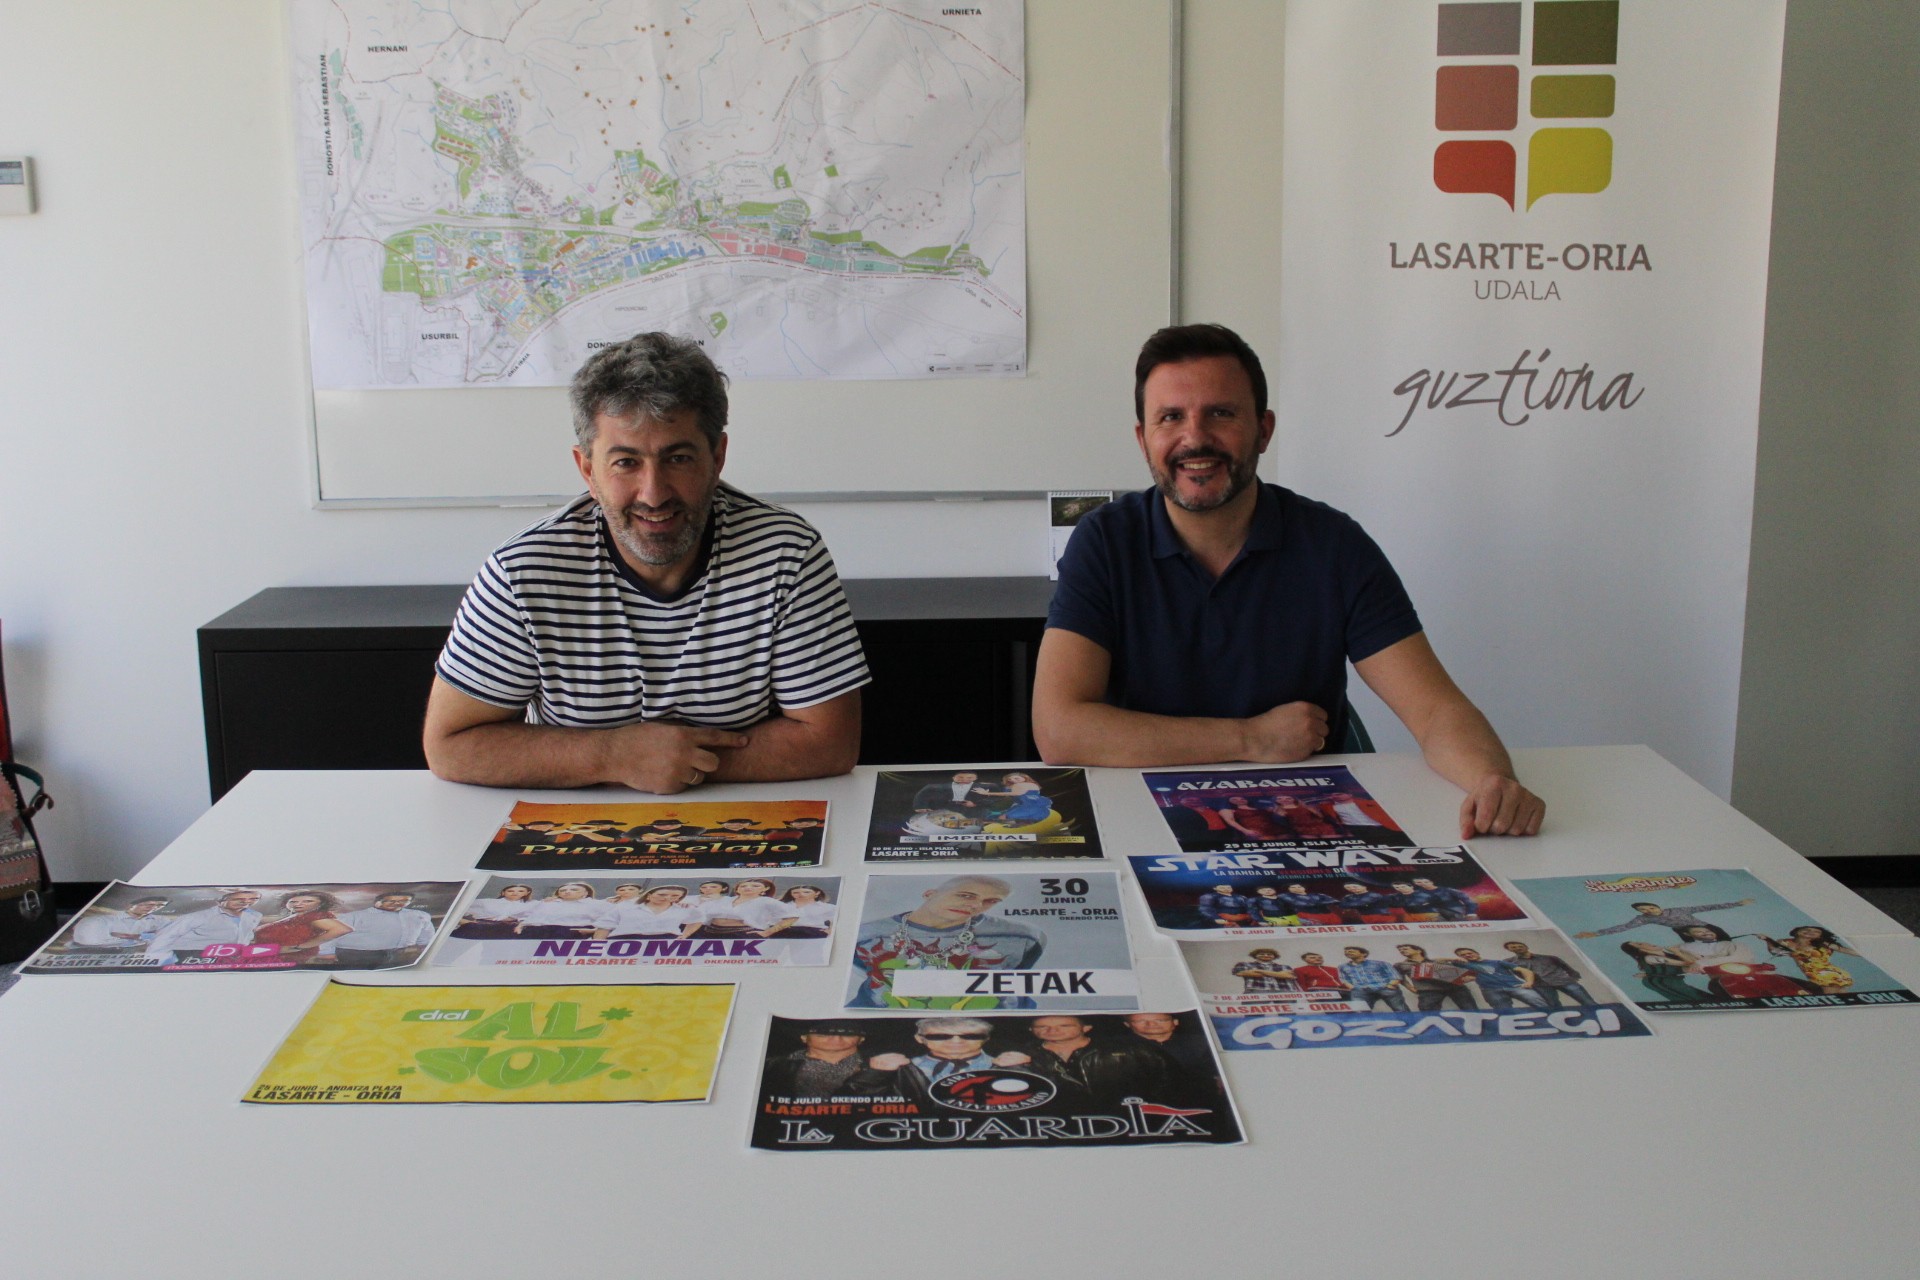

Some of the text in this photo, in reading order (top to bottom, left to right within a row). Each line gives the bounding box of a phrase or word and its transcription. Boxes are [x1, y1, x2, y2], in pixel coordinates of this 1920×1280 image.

[942, 8, 983, 16] URNIETA
[367, 45, 408, 53] HERNANI
[320, 54, 329, 105] SEBASTIAN
[1389, 242, 1652, 272] LASARTE-ORIA
[1474, 280, 1562, 301] UDALA
[421, 333, 460, 341] USURBIL
[1384, 348, 1645, 437] guztiona
[518, 842, 798, 856] Puro Relajo
[1147, 846, 1464, 872] STAR WAYS
[1040, 878, 1089, 896] 30
[1004, 908, 1067, 916] LASARTE
[1082, 908, 1118, 916] ORIA
[1286, 925, 1357, 934] LASARTE
[533, 940, 766, 957] NEOMAK
[32, 959, 104, 967] LASARTE
[121, 958, 160, 966] ORIA
[565, 958, 639, 966] LASARTE
[654, 958, 693, 966] ORIA
[964, 971, 1097, 994] ZETAK
[1761, 994, 1846, 1007] LASARTE
[1857, 992, 1909, 1003] ORIA
[419, 1009, 470, 1021] dial
[1215, 1004, 1294, 1014] LASARTE
[1309, 1003, 1352, 1011] ORIA
[454, 1001, 608, 1041] AL
[1232, 1008, 1621, 1049] GOZATEGI
[414, 1046, 618, 1090] SOL
[940, 1072, 977, 1087] GIRA
[252, 1090, 337, 1100] LASARTE
[356, 1091, 402, 1100] ORIA
[831, 1096, 871, 1104] OKENDO
[764, 1103, 852, 1116] LASARTE
[871, 1104, 919, 1114] ORIA
[854, 1098, 1212, 1143] GUARDIA
